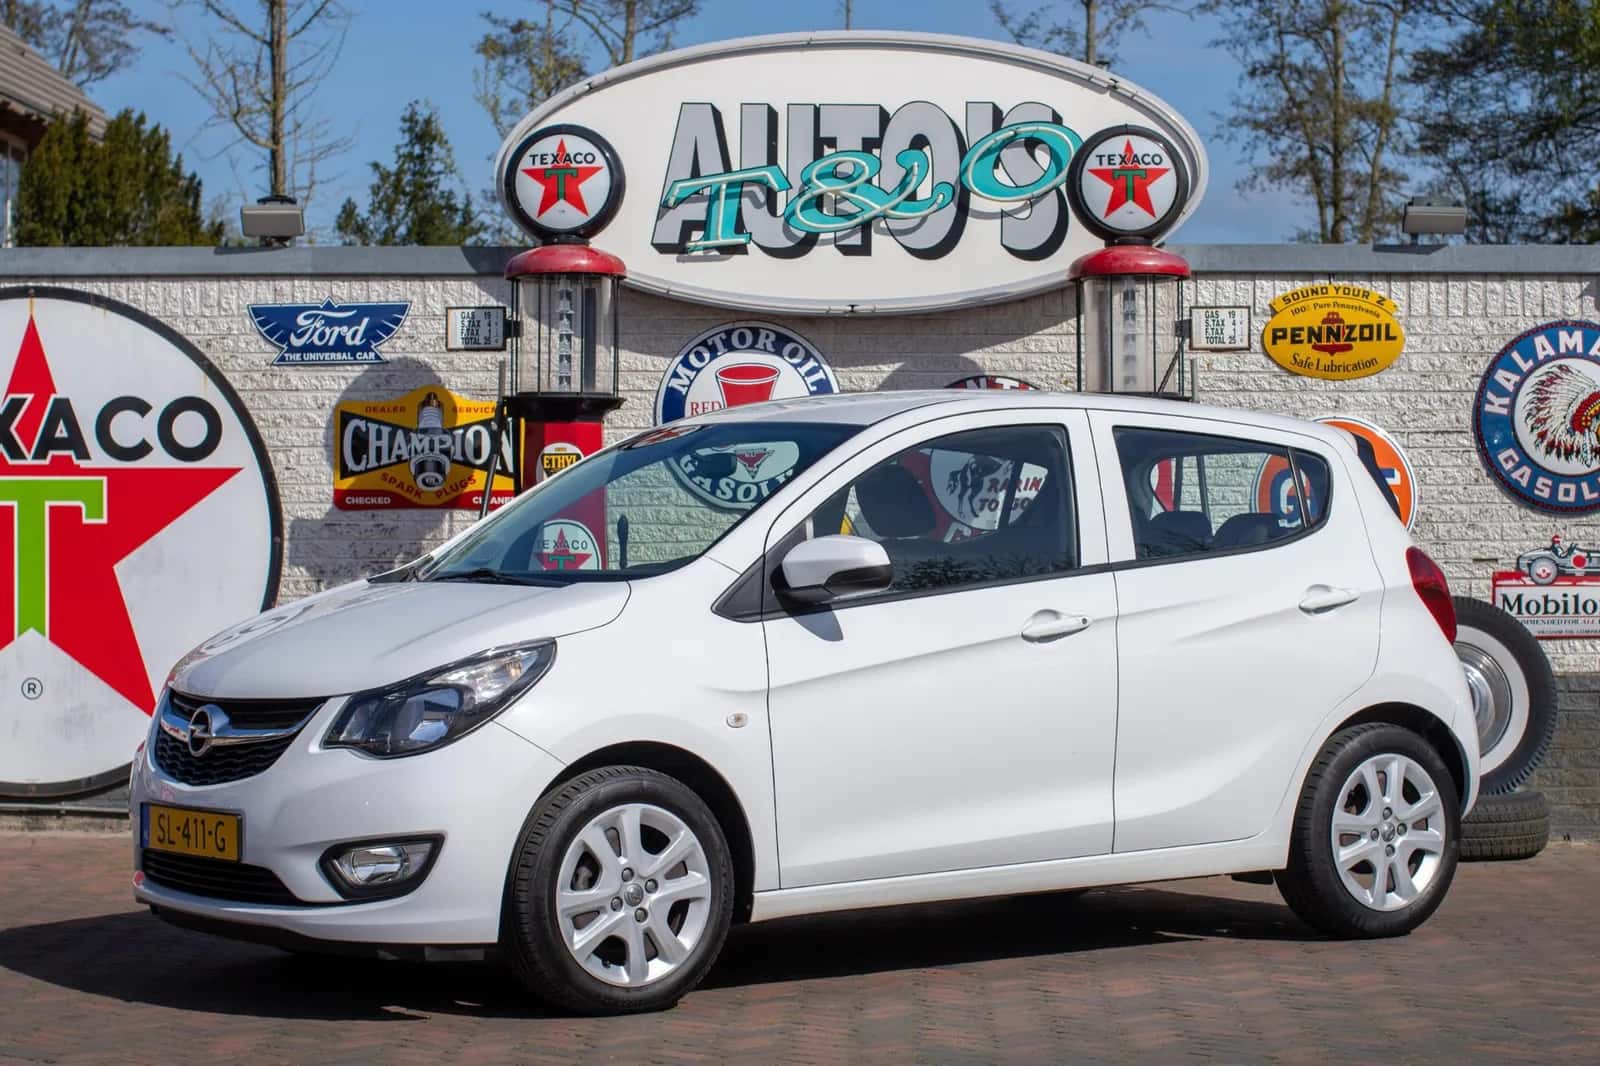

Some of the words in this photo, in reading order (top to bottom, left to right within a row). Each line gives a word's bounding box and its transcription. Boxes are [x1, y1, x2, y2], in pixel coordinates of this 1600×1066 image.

[529, 152, 596, 166] TEXACO
[1096, 153, 1164, 166] TEXACO
[544, 168, 578, 200] T
[1112, 169, 1147, 202] T
[1281, 286, 1329, 305] SOUND
[1333, 285, 1371, 300] YOUR
[1375, 296, 1387, 306] Z
[1313, 302, 1332, 310] Pure
[1204, 310, 1220, 319] GAS
[289, 309, 370, 347] Ford
[1271, 322, 1398, 346] PENNZOIL
[461, 336, 482, 345] TOTAL
[1205, 335, 1226, 345] TOTAL
[284, 352, 302, 361] THE
[303, 352, 354, 361] UNIVERSAL
[355, 351, 376, 361] CAR
[668, 327, 778, 396] MOTOR
[781, 341, 828, 392] OIL
[1289, 352, 1315, 371] Safe
[1315, 357, 1379, 373] Lubrication
[364, 405, 407, 414] DEALER
[690, 401, 723, 417] RED
[342, 417, 514, 473] CHAMPION
[380, 471, 424, 499] SPARK
[434, 474, 477, 499] PLUGS
[1497, 447, 1600, 502] GASOL
[345, 495, 392, 505] CHECKED
[156, 812, 227, 853] SL-411-G
